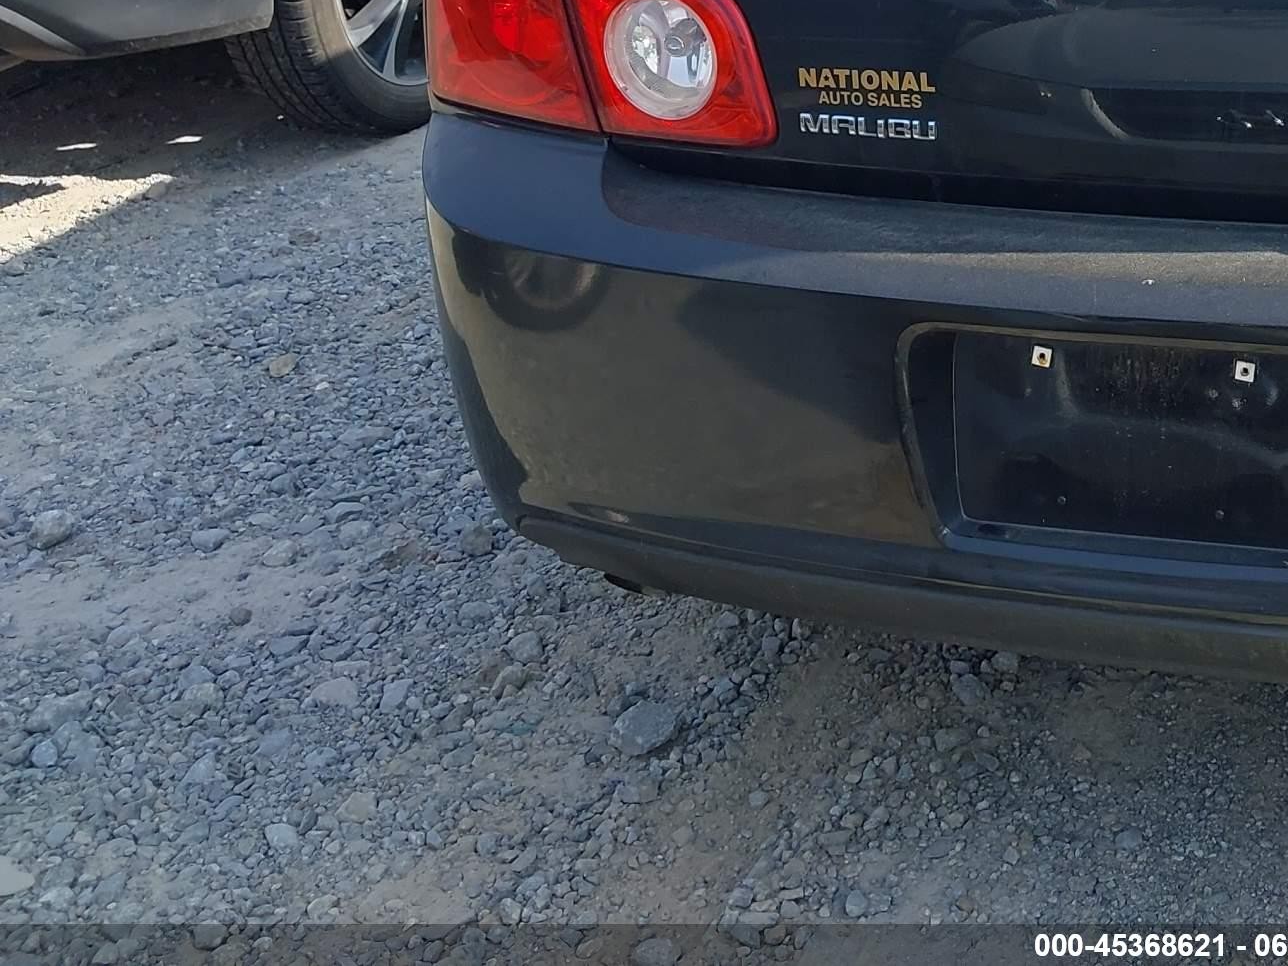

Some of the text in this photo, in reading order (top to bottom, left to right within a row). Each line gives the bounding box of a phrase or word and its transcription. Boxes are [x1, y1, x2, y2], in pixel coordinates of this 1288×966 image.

[798, 67, 937, 93] NATIONAL
[819, 91, 923, 110] AUTO SALES
[799, 113, 938, 141] MALIBU
